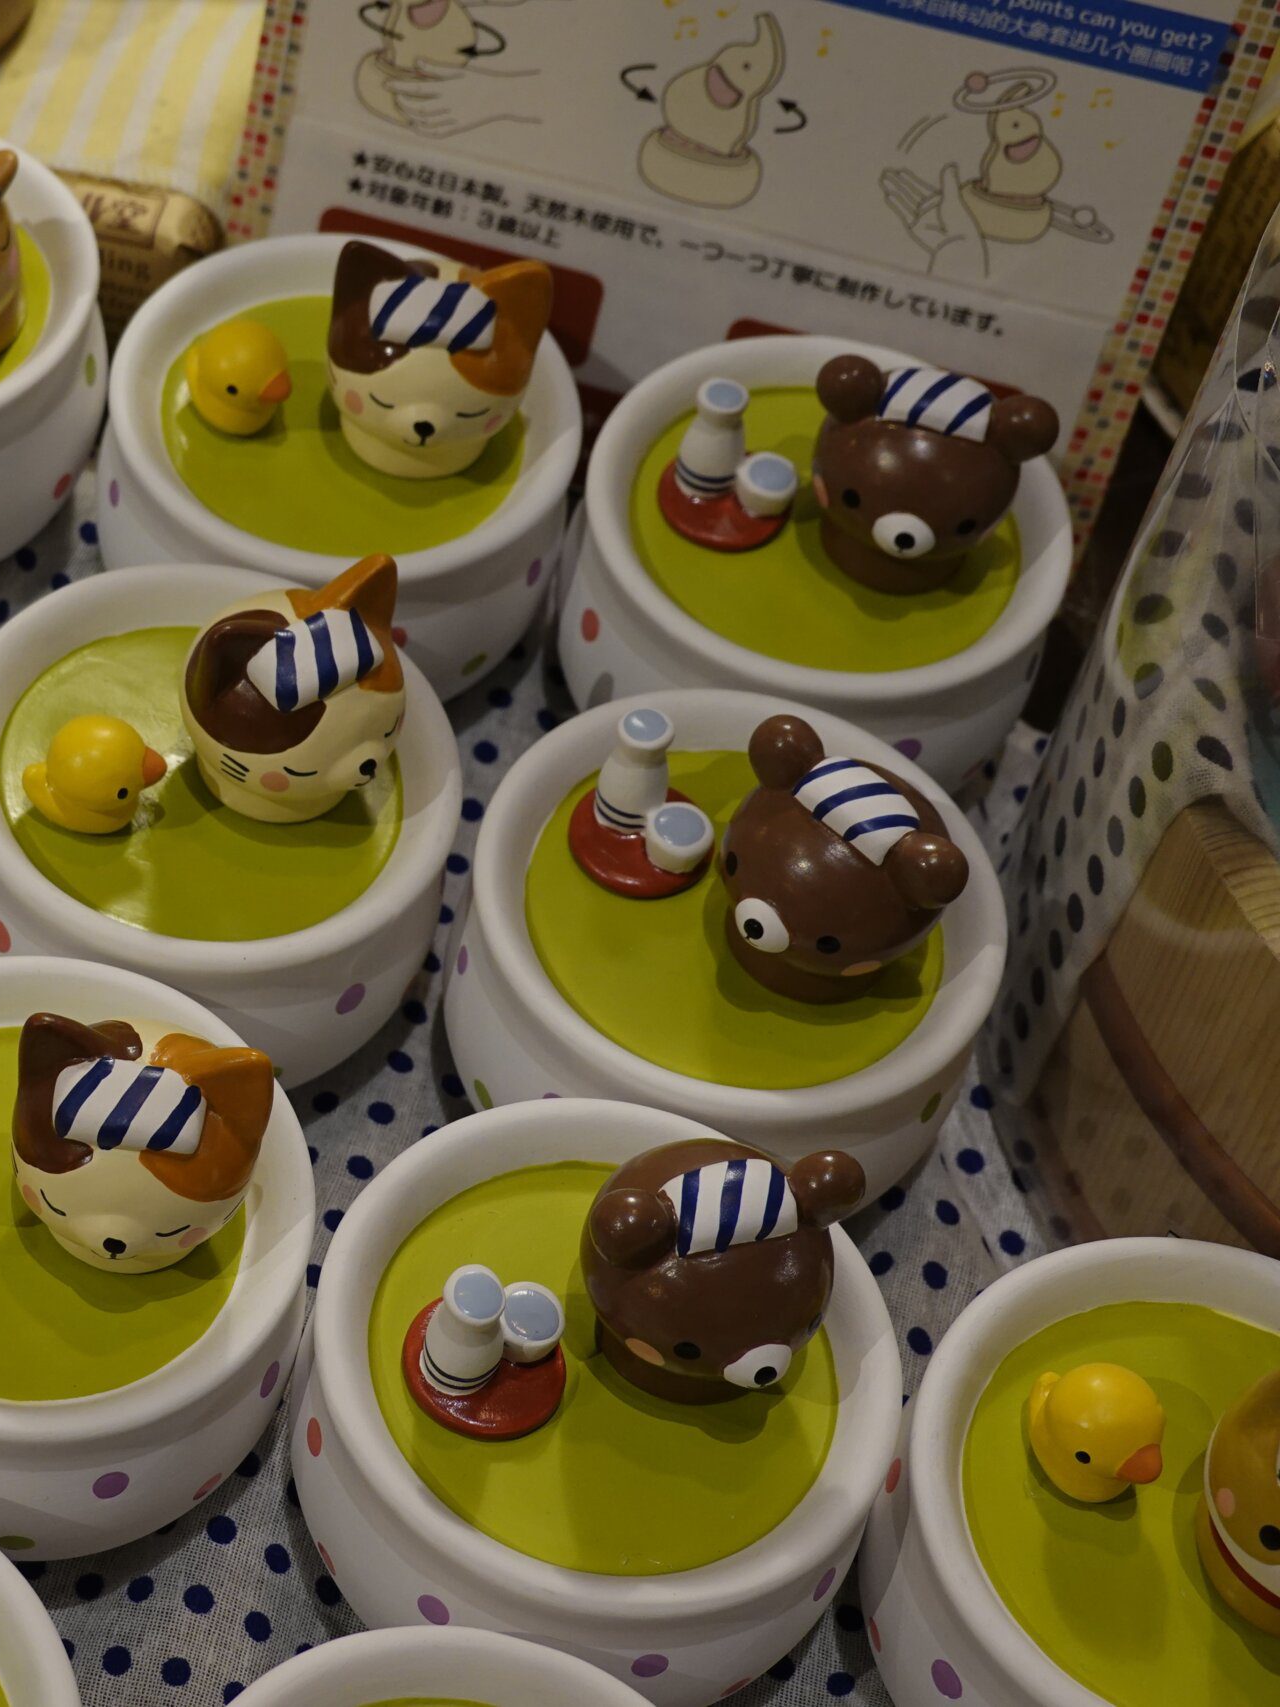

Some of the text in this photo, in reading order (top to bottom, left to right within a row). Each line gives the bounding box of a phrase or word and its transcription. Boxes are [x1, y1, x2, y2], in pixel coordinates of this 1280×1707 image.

[1008, 0, 1213, 52] points can you get?
